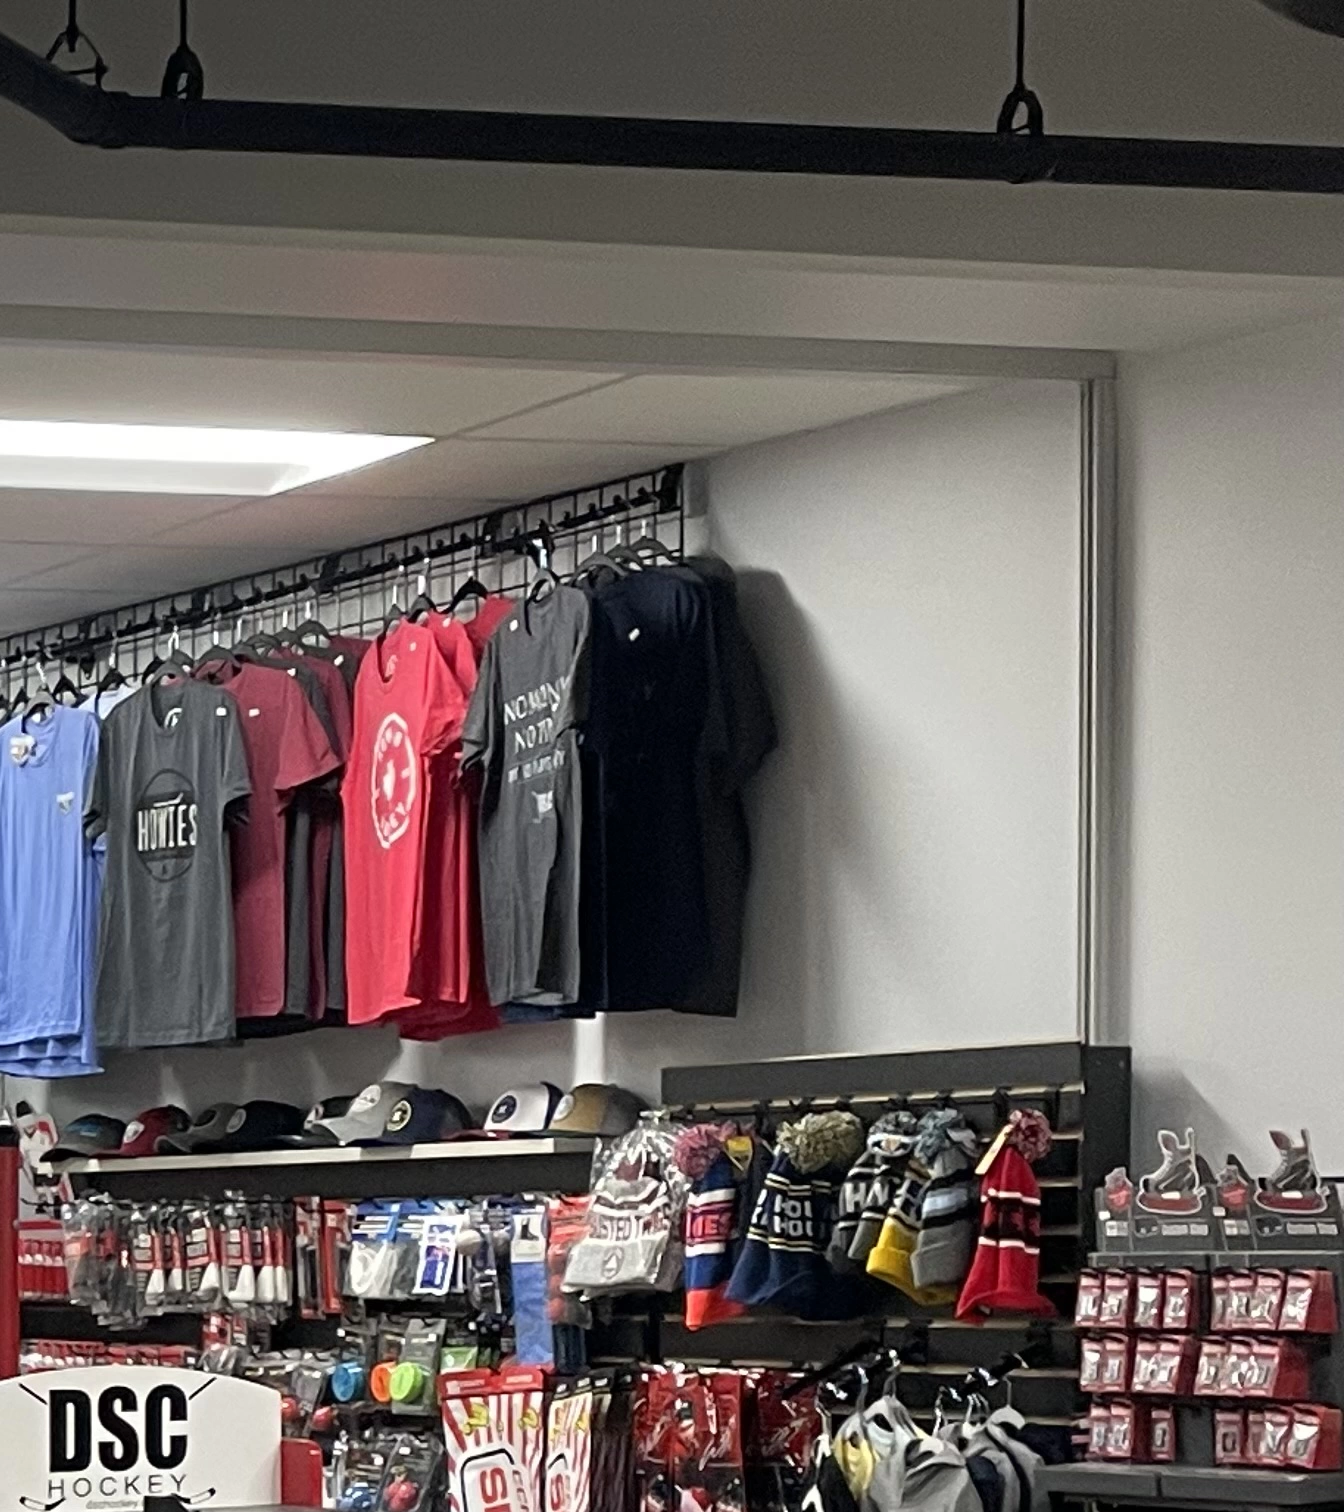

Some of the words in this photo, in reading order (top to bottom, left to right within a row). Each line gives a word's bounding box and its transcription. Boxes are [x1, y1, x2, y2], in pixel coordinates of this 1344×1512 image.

[137, 803, 198, 852] HOWIES
[48, 1383, 189, 1473] DSC
[48, 1473, 188, 1498] HOCKEY
